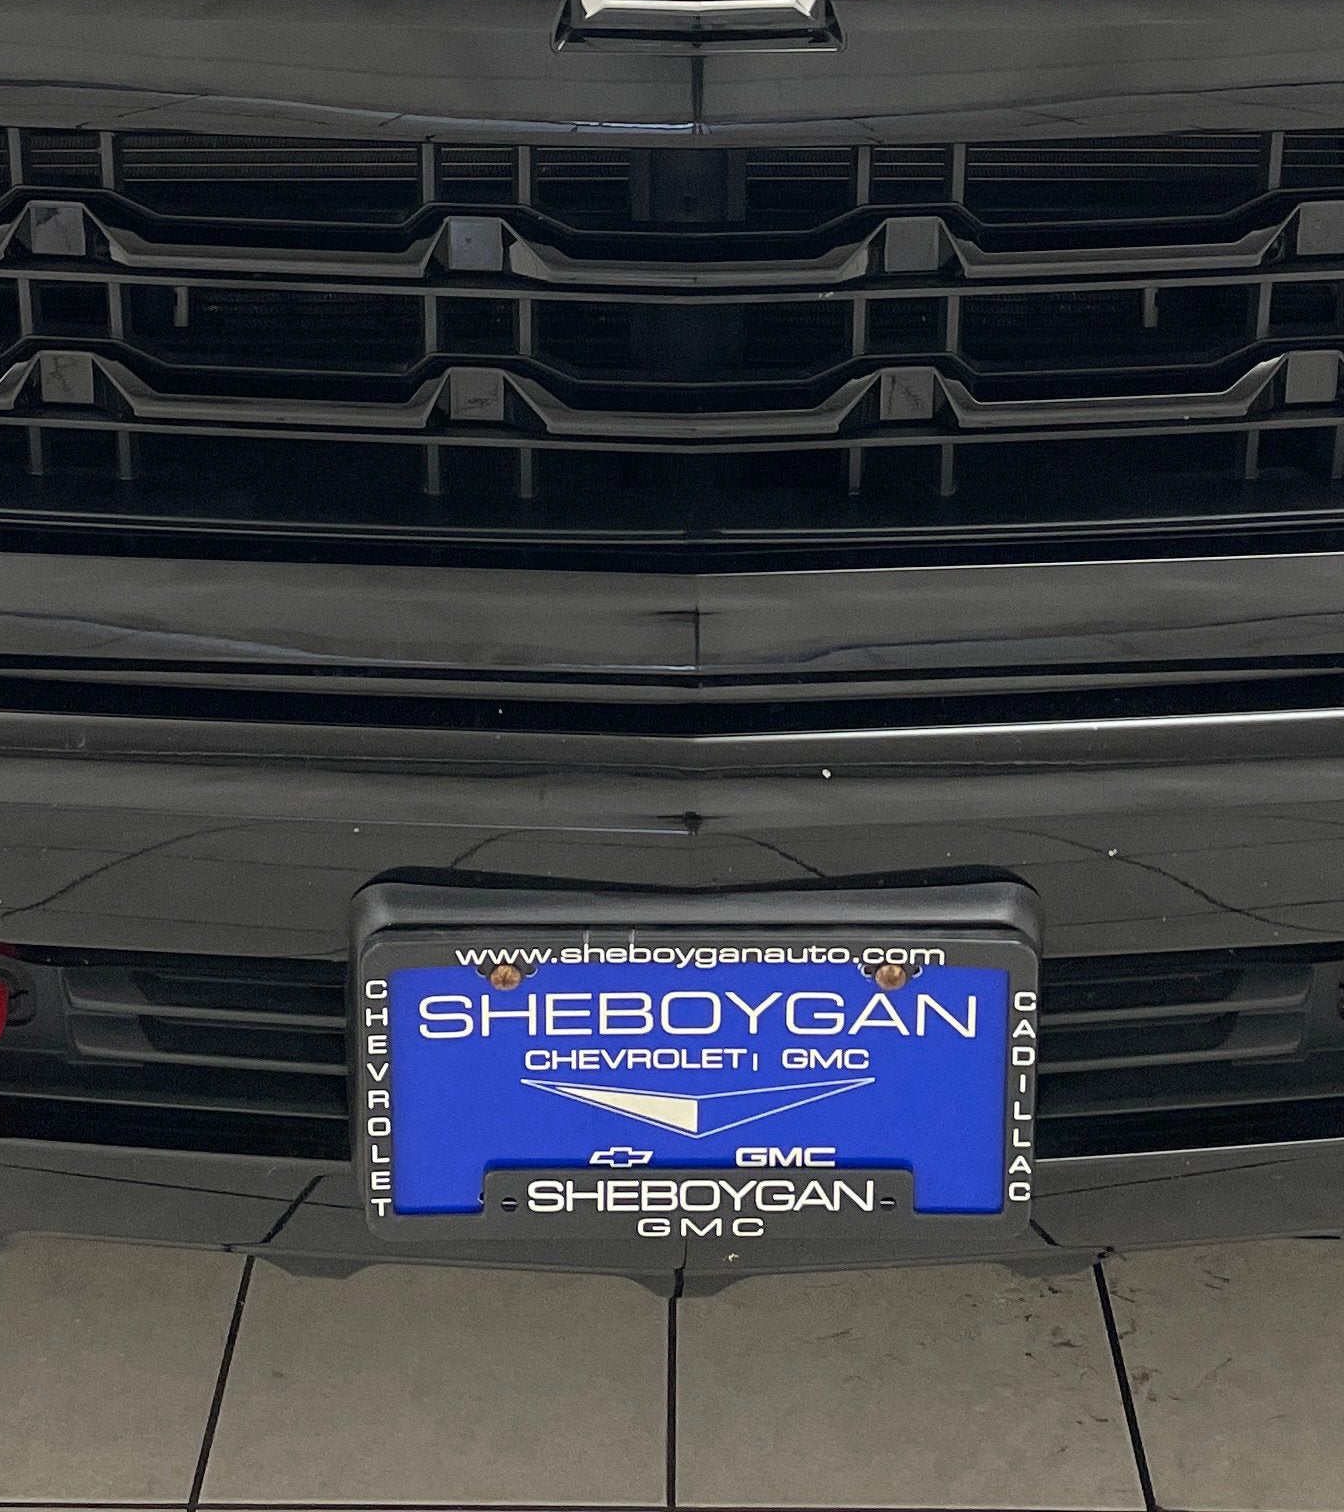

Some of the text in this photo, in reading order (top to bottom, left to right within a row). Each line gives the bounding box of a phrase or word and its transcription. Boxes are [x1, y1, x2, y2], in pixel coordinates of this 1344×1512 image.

[455, 943, 945, 968] www.sheboyganauto.com
[418, 990, 977, 1039] SHEBOYGAN
[524, 1048, 870, 1071] CHEVROLET GMC
[365, 979, 392, 1217] CHEVROLET
[1008, 991, 1037, 1202] CADILLAC
[734, 1146, 837, 1168] GMC
[526, 1179, 875, 1212] SHEBOYGAN
[636, 1217, 765, 1238] GMC
